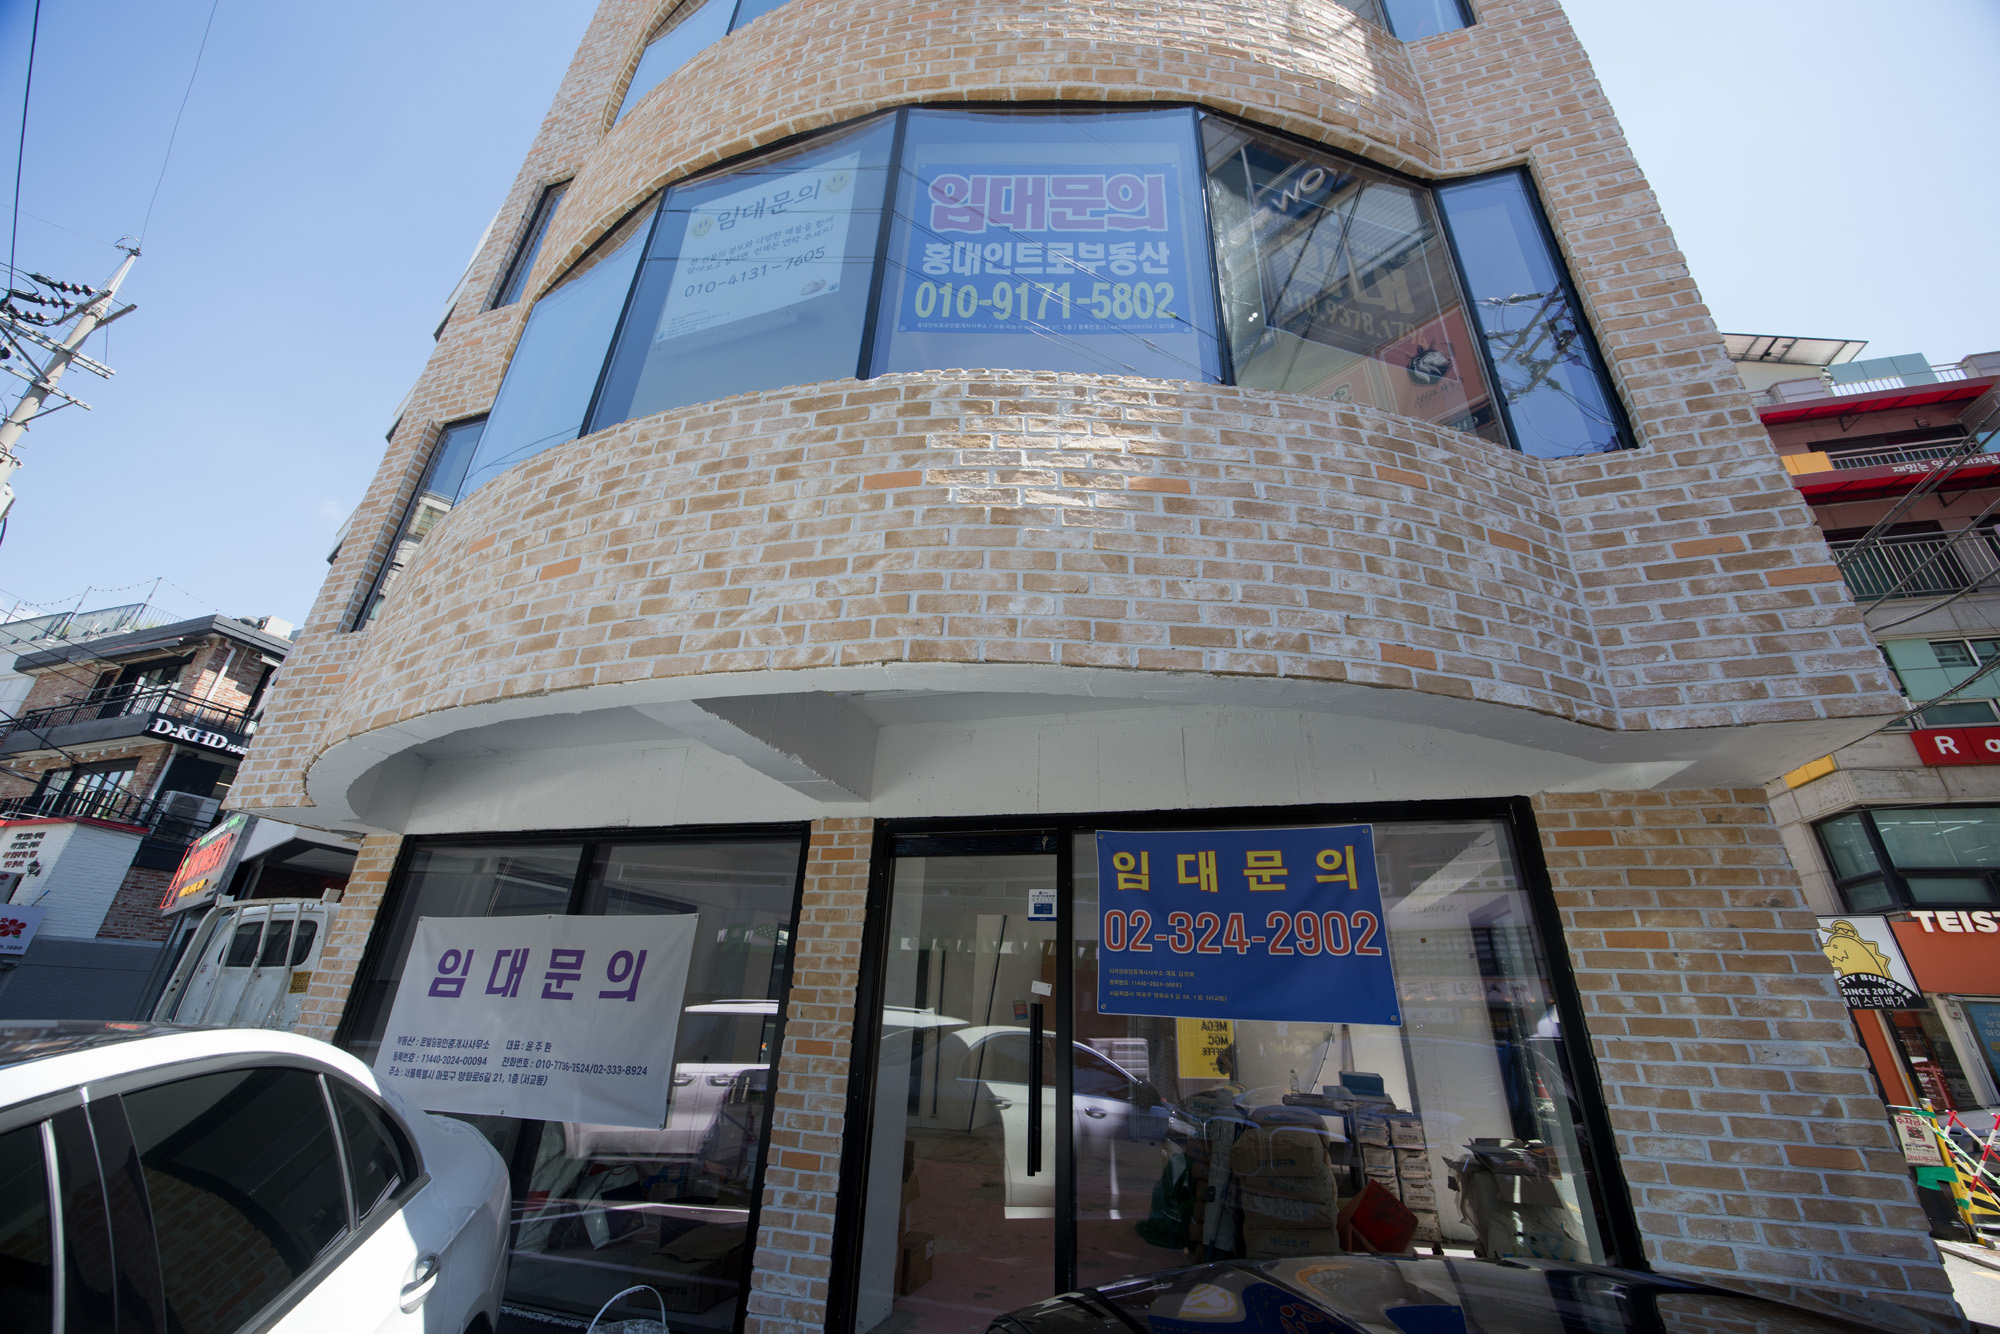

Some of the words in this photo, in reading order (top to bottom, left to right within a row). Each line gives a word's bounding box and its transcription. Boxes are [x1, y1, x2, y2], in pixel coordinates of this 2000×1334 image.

[717, 179, 822, 231] 임대문의
[928, 173, 1168, 233] 임대문의
[729, 239, 753, 255] 정보와
[757, 231, 782, 245] 다양한
[783, 235, 800, 247] 연락
[685, 246, 825, 298] 010-4131-7605
[922, 241, 1171, 276] 홍대인트로부동산
[914, 281, 1176, 320] 010-9171-5802
[1104, 909, 1383, 956] 02-324-2902
[1842, 988, 1871, 996] SINCE
[1871, 987, 1895, 996] 2018
[1859, 973, 1913, 1000] BURGER
[420, 1036, 490, 1050] 문빌딩공인중개사사무소
[403, 1068, 435, 1080] 서울특별시
[435, 1071, 457, 1081] 마포구
[457, 1071, 492, 1083] 양화로6길
[507, 1073, 519, 1085] 1층
[520, 1073, 548, 1087] (서교동)
[421, 1053, 488, 1066] 11440-2024-00094
[535, 1059, 648, 1076] 010-7736-2524/02-333-8924
